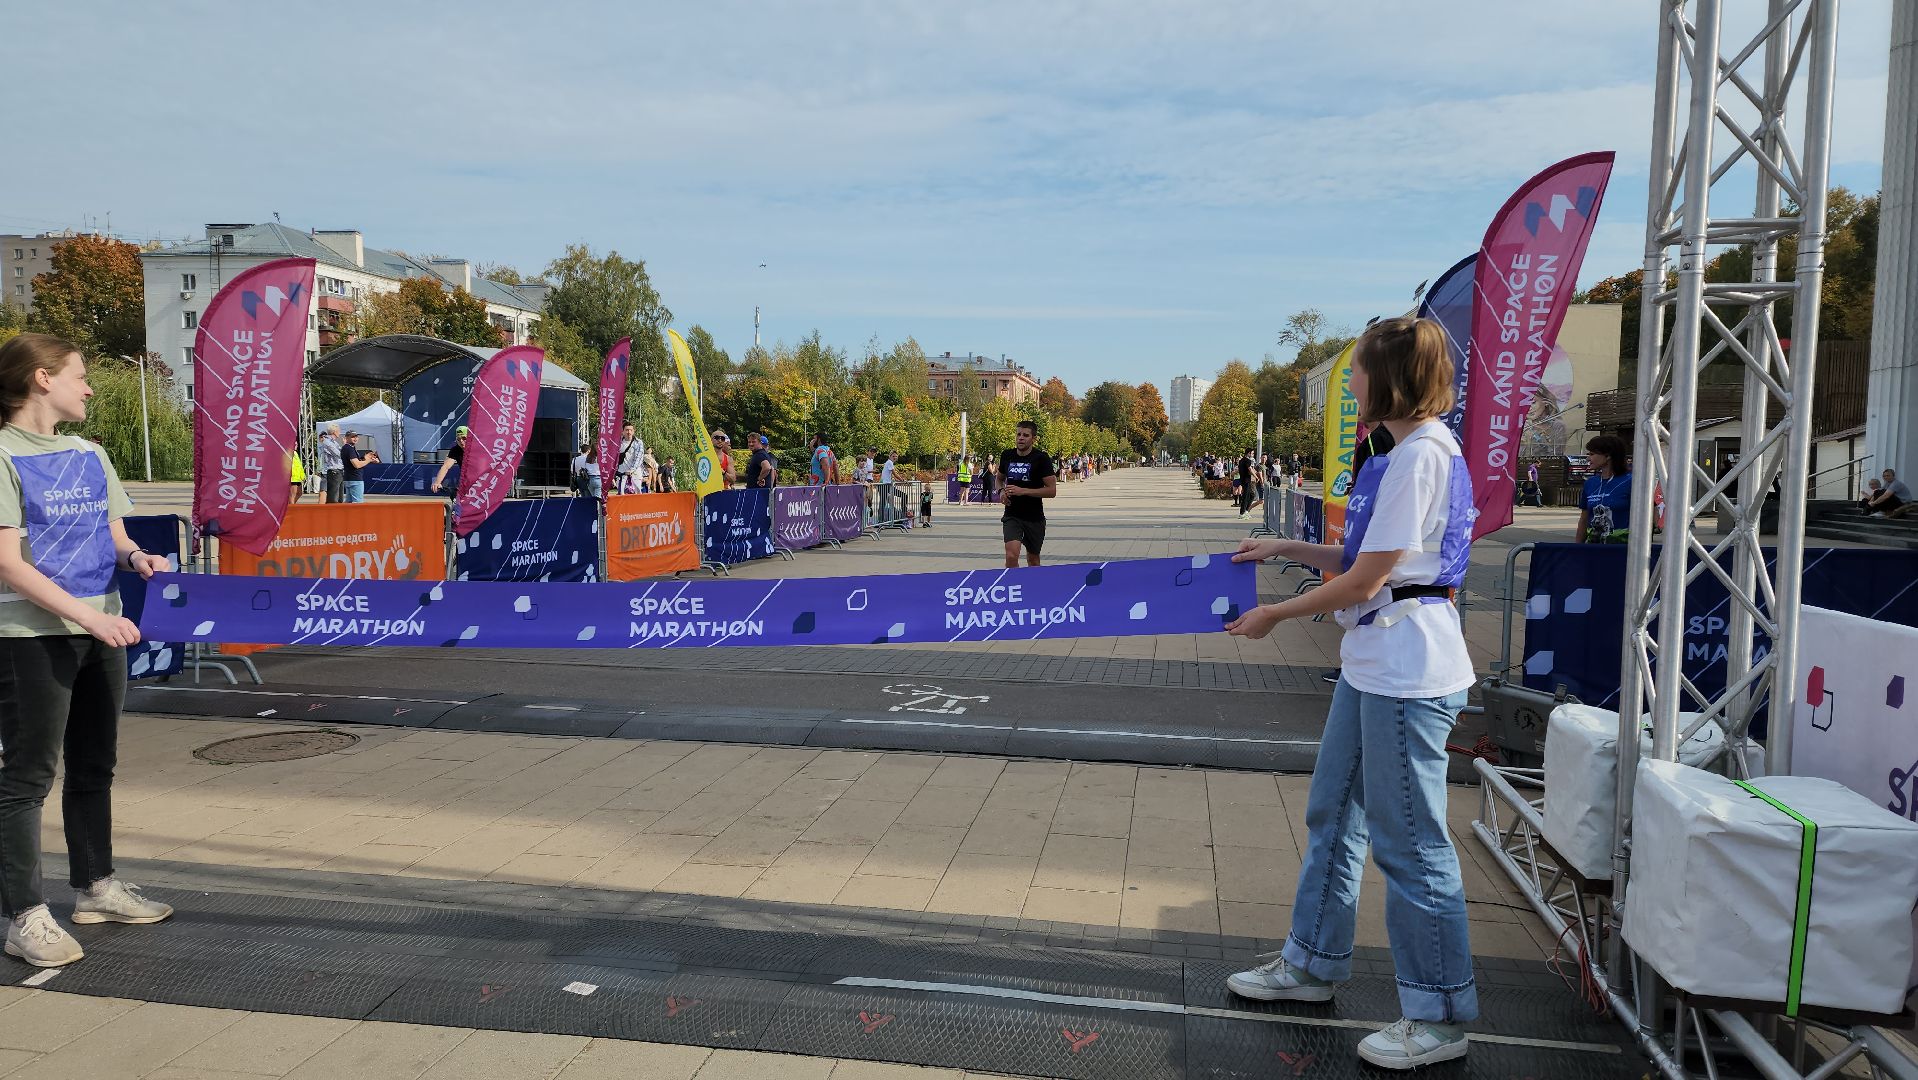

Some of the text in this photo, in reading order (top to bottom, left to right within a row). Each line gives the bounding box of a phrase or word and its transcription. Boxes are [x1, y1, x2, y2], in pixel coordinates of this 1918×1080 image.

[1500, 253, 1532, 344] SPACE
[1493, 351, 1516, 409] AND
[495, 384, 514, 436] SPACE
[224, 405, 244, 452] AND
[43, 486, 91, 502] SPACE
[234, 457, 264, 514] HALF
[45, 499, 108, 517] MARATHO
[267, 532, 378, 552] ффективные средства
[511, 539, 539, 553] SPACE
[511, 551, 558, 568] MARATHON
[295, 593, 370, 612] SPACE
[944, 584, 1023, 606] SPACE
[629, 597, 705, 616] SPACE
[292, 617, 426, 636] MARATHON
[945, 605, 1086, 629] MARATHON
[629, 620, 764, 638] MARATHON
